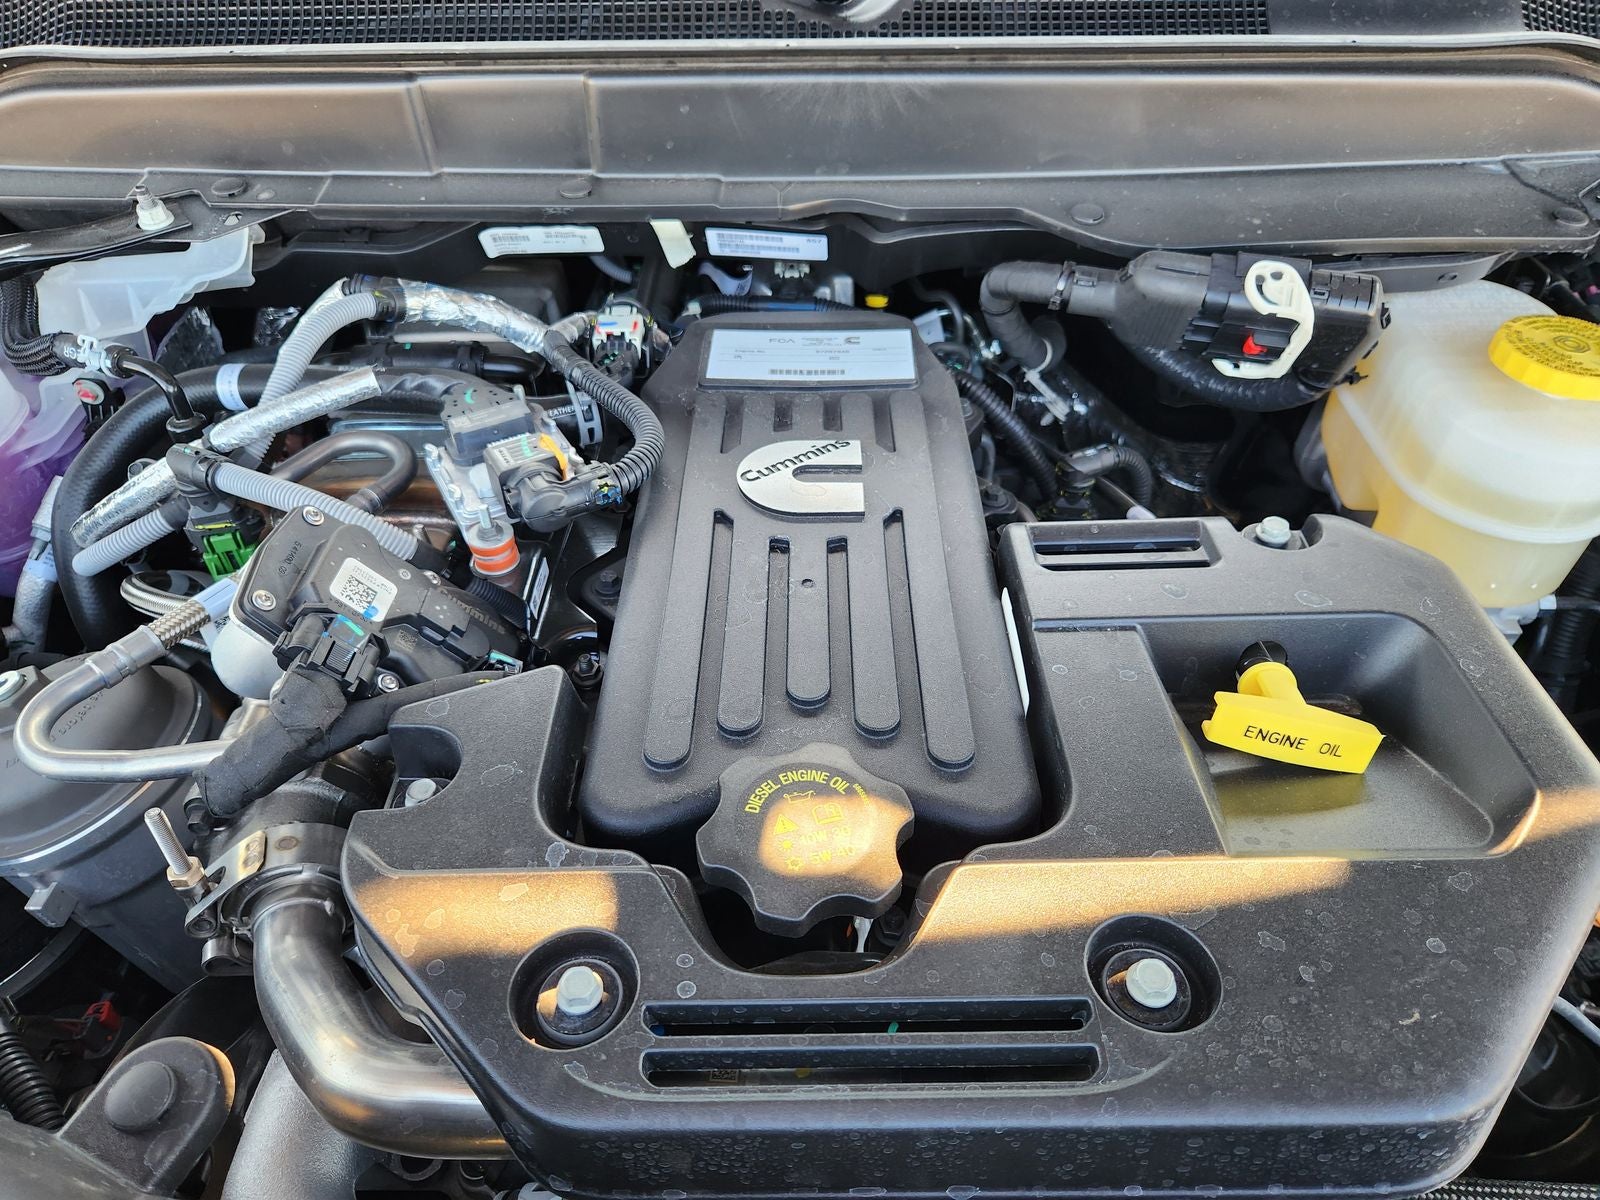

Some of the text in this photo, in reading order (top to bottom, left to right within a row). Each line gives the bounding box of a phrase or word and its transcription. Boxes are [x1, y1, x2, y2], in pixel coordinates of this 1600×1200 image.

[63, 346, 81, 360] GR
[739, 439, 851, 482] Cummins
[1243, 725, 1342, 758] ENGINE OIL
[744, 780, 781, 814] DIESEL
[778, 769, 830, 785] ENGINE
[829, 776, 850, 795] OIL
